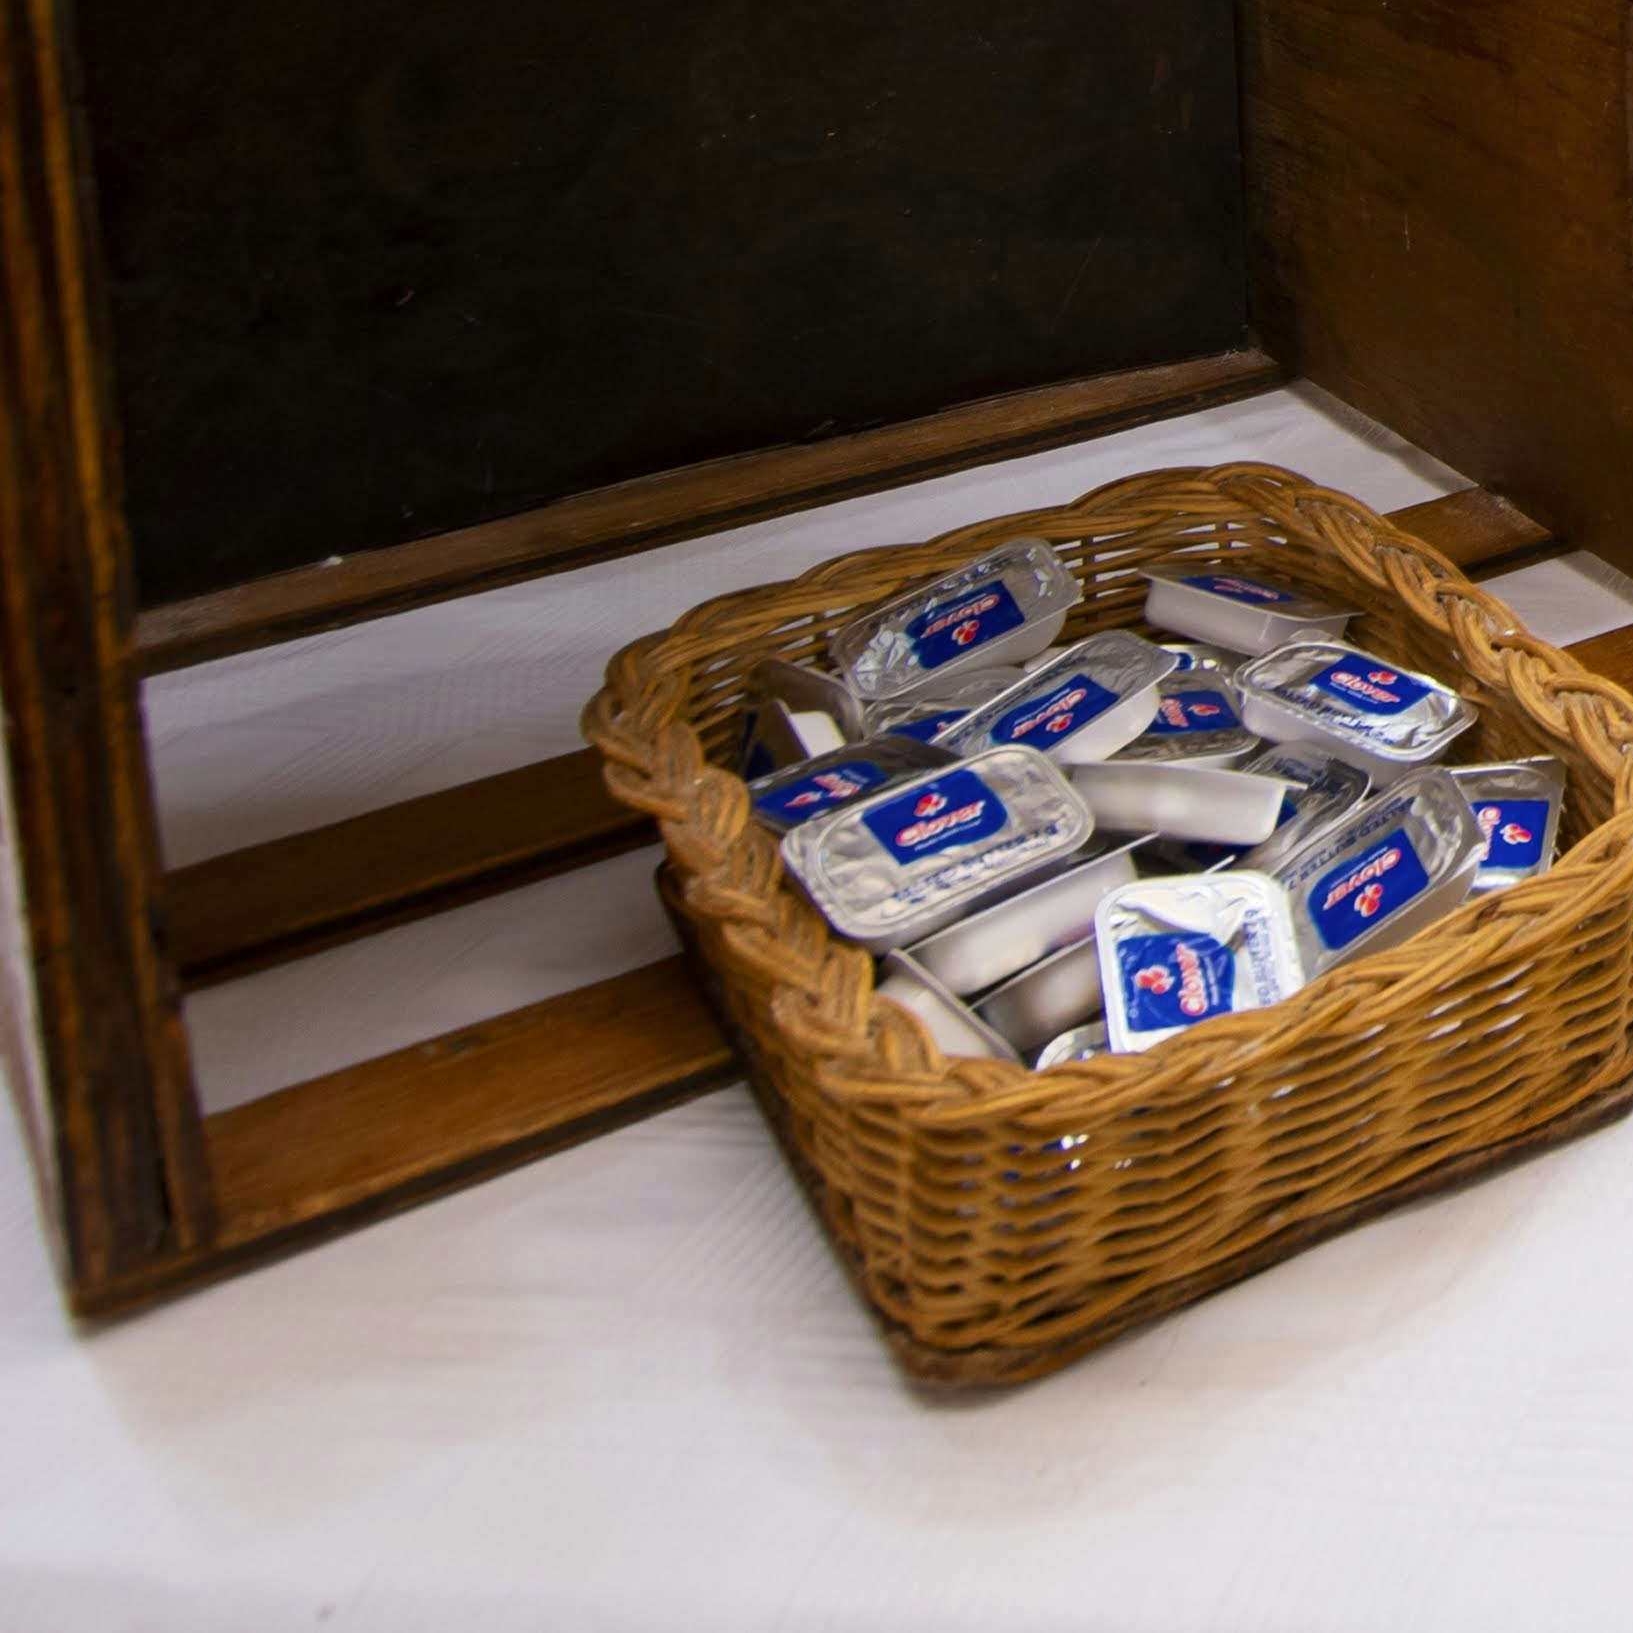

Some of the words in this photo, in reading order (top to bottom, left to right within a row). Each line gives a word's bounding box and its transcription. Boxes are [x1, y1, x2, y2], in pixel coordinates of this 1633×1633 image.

[920, 594, 1000, 639] Clover
[1329, 670, 1401, 704] Clover
[1010, 688, 1088, 739] Clover
[895, 799, 985, 848] Clover
[1322, 847, 1403, 912] Clover
[1175, 942, 1209, 1016] Clover
